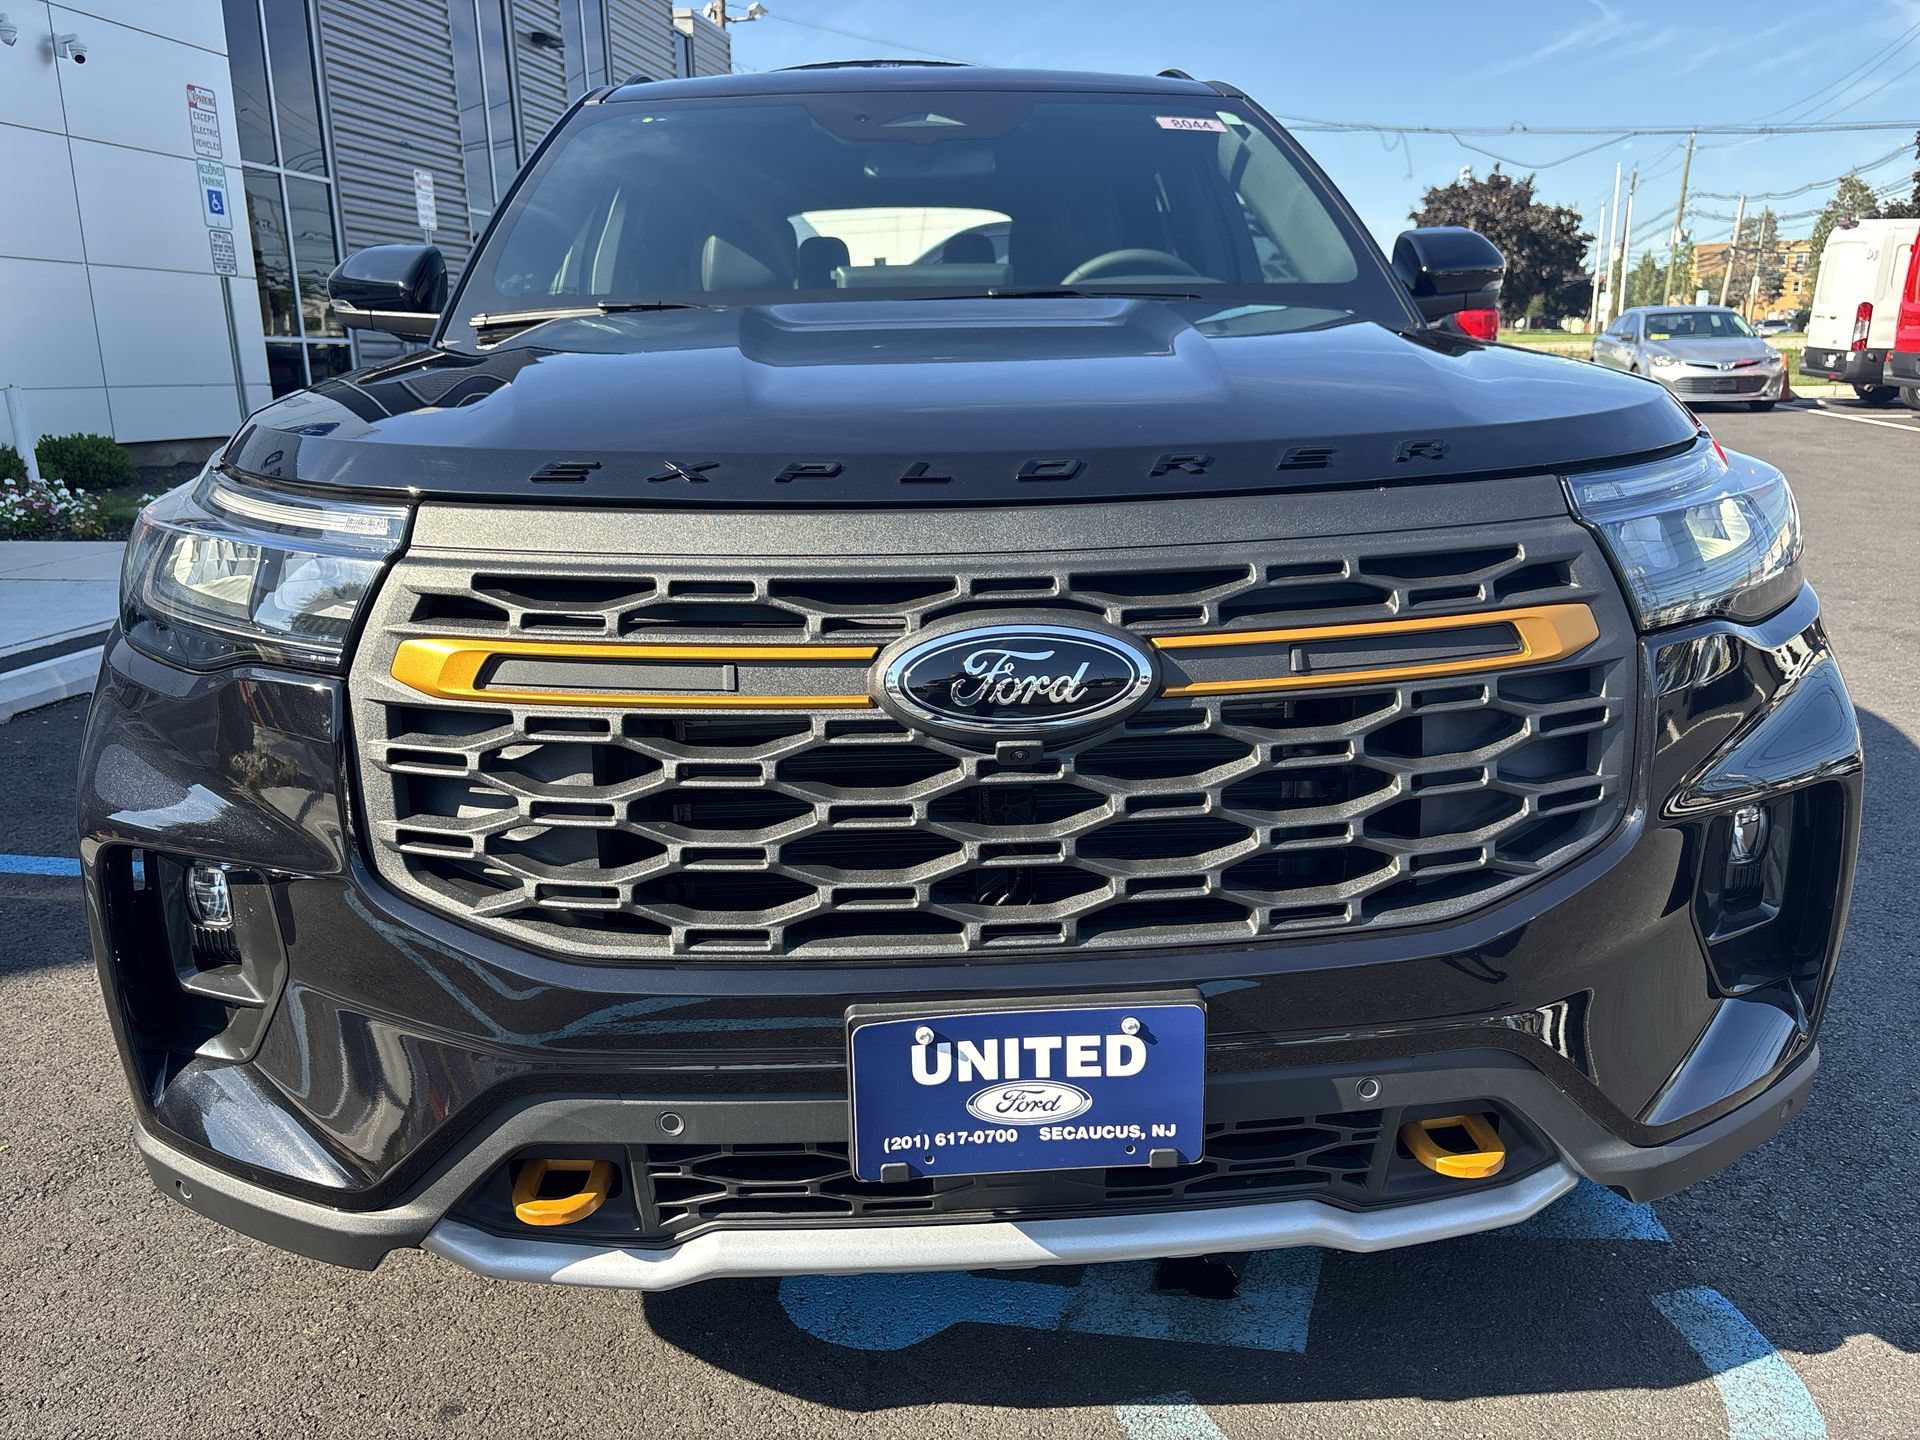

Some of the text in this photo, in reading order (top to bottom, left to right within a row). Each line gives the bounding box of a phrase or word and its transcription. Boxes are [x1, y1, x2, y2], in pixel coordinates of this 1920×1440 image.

[194, 111, 214, 124] EXCEPT
[1171, 119, 1214, 129] 8044
[193, 125, 218, 138] ELECTRIC
[195, 139, 220, 151] VEHICLES
[198, 164, 224, 177] RESERVED
[202, 176, 224, 188] PARKING
[529, 438, 1448, 483] EXPLORER
[951, 649, 1091, 707] Ford
[911, 1034, 1147, 1086] UNITED
[996, 1089, 1063, 1114] Ford
[883, 1124, 1176, 1153] (201) 617-0700 SECAUCUS, NJ
